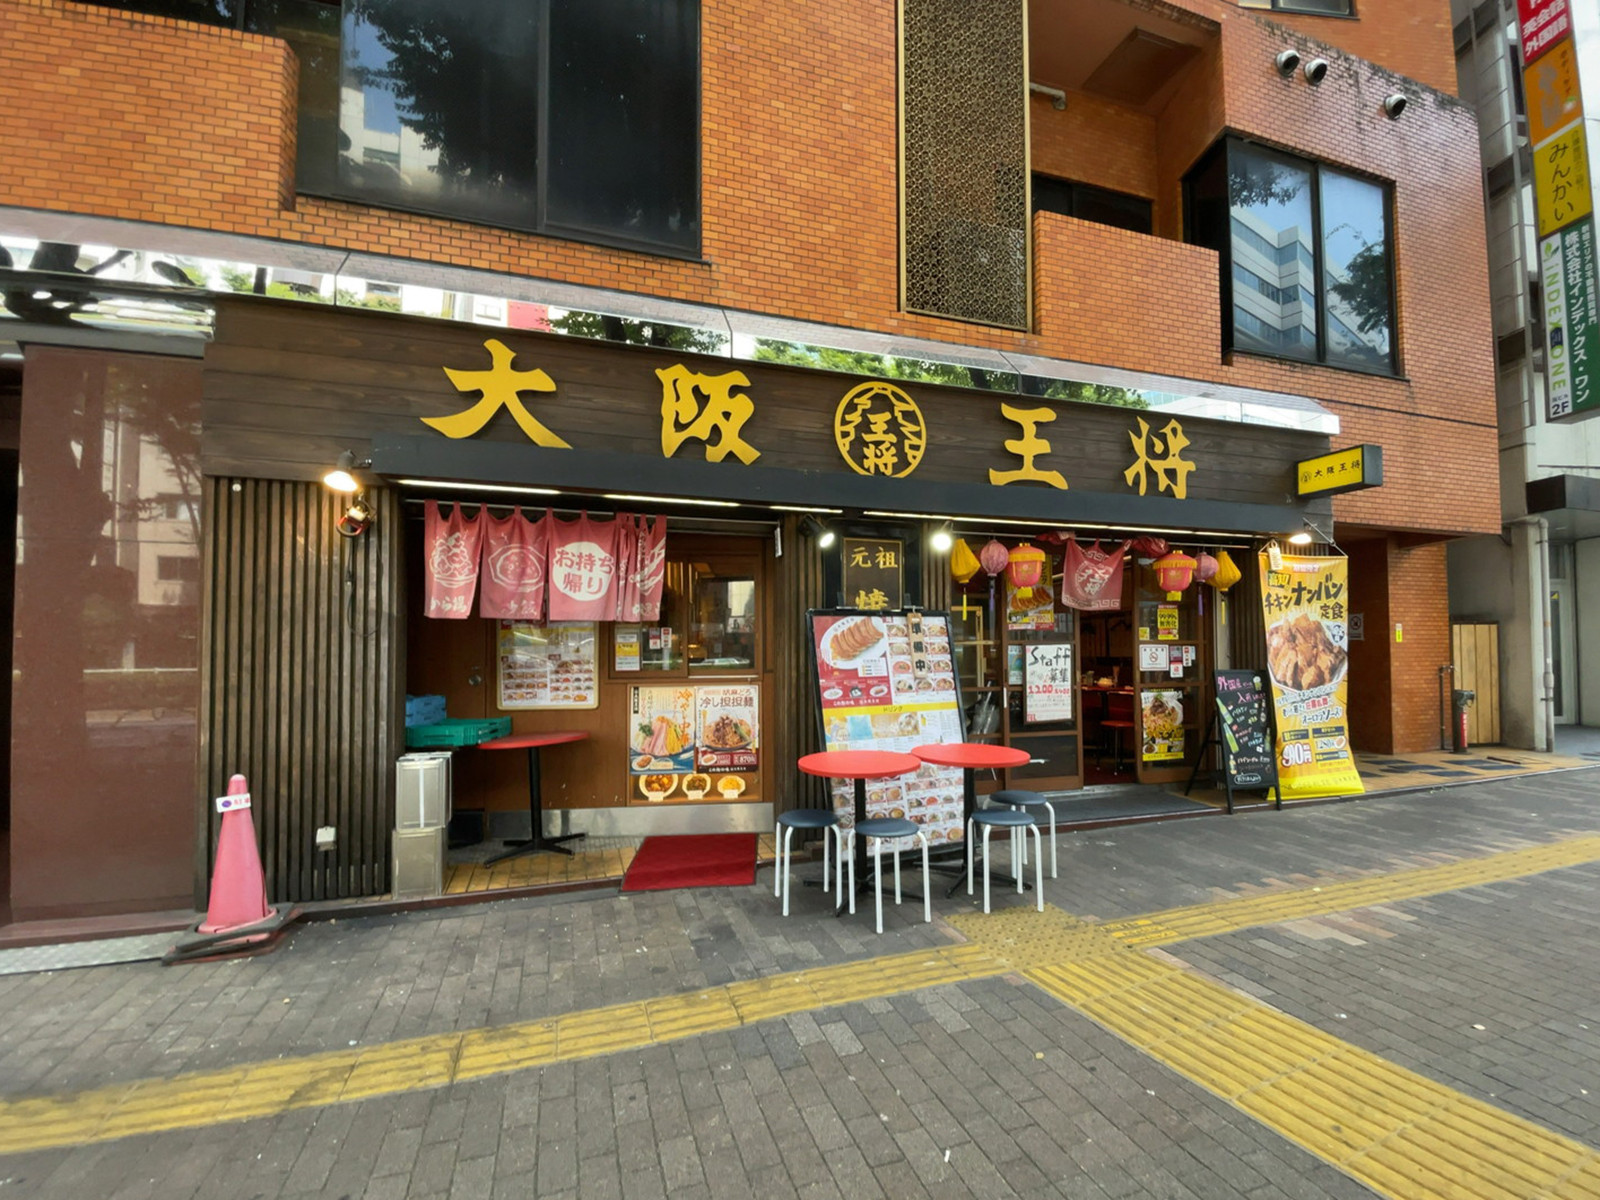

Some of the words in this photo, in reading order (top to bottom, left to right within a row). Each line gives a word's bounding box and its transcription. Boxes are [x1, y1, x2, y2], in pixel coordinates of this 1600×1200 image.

[1549, 143, 1574, 221] みんかい
[1552, 401, 1569, 415] 2F
[862, 412, 898, 475] 王将
[1314, 460, 1360, 478] 大阪王将
[555, 550, 614, 575] お持ち
[850, 546, 898, 569] 元祖
[563, 572, 603, 595] 帰り
[1320, 601, 1344, 620] 定食
[1028, 646, 1071, 666] Staff
[1049, 668, 1069, 683] 募集
